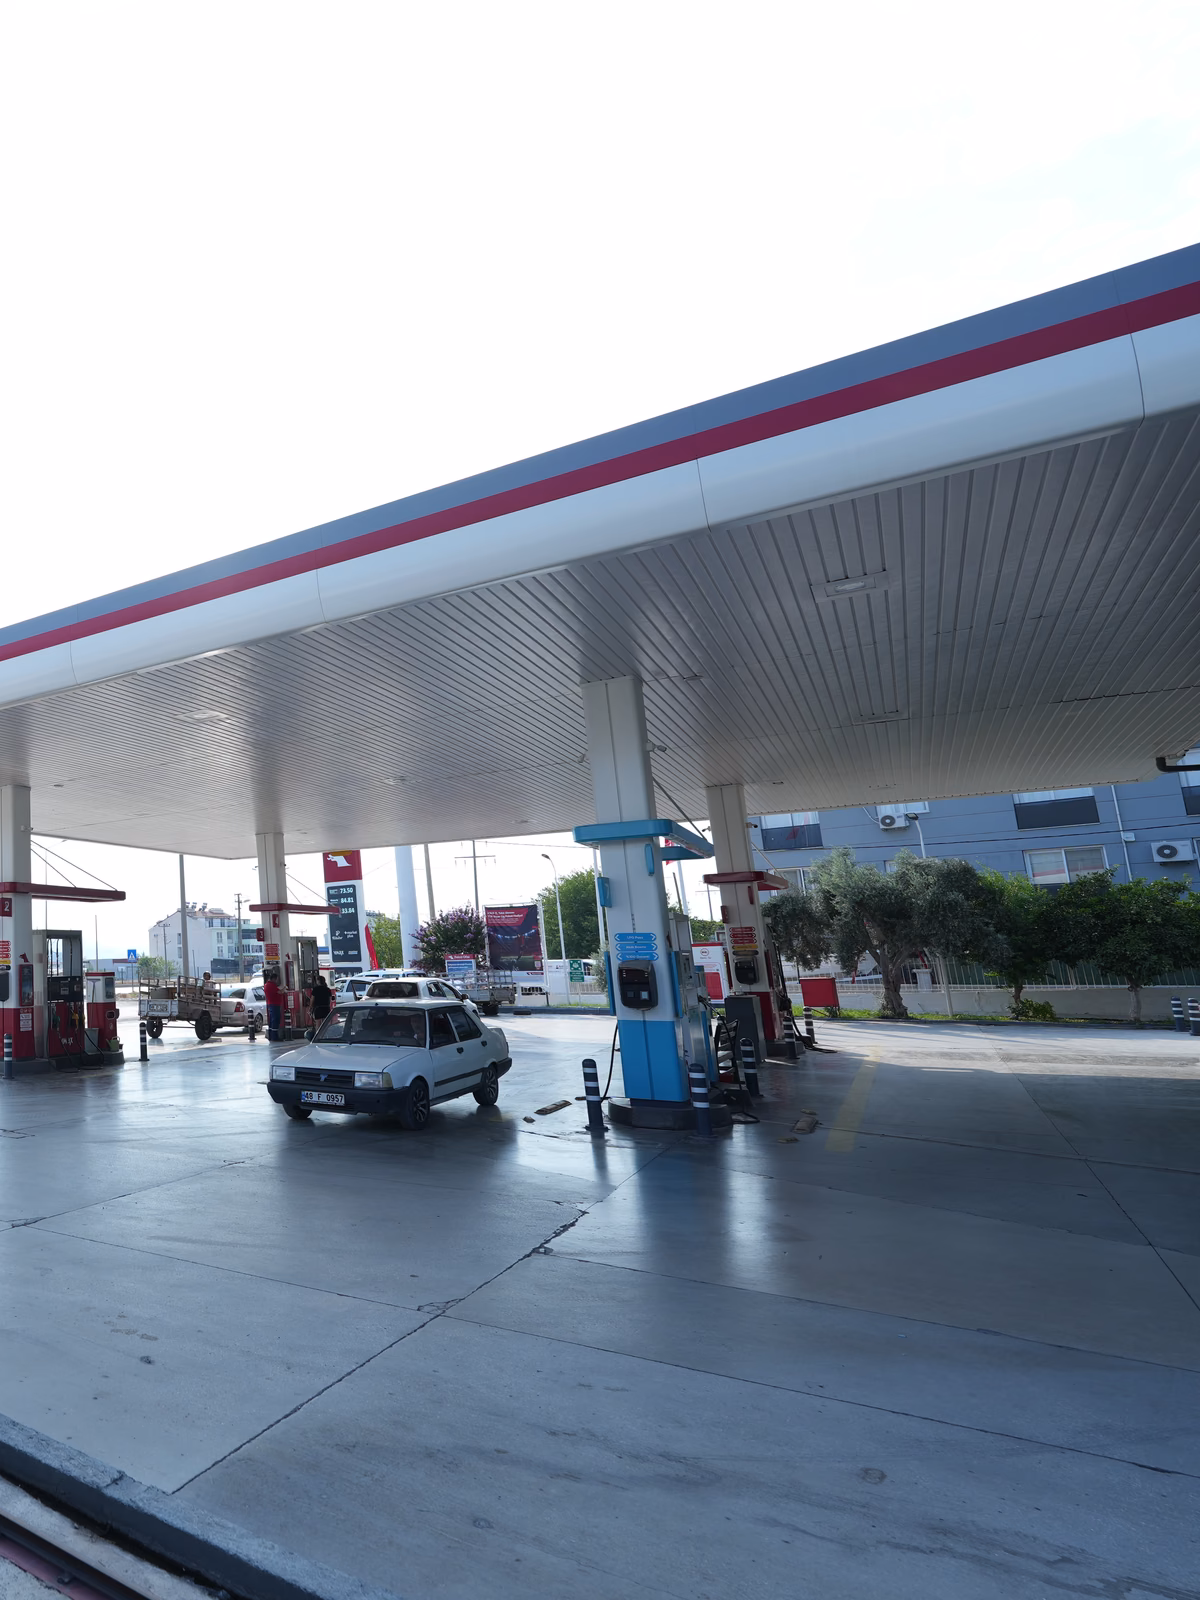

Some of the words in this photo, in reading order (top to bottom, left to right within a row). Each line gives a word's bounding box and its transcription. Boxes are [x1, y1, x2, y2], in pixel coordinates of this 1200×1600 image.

[4, 901, 10, 912] 2
[305, 1092, 314, 1100] 48
[326, 1094, 344, 1103] 0957
